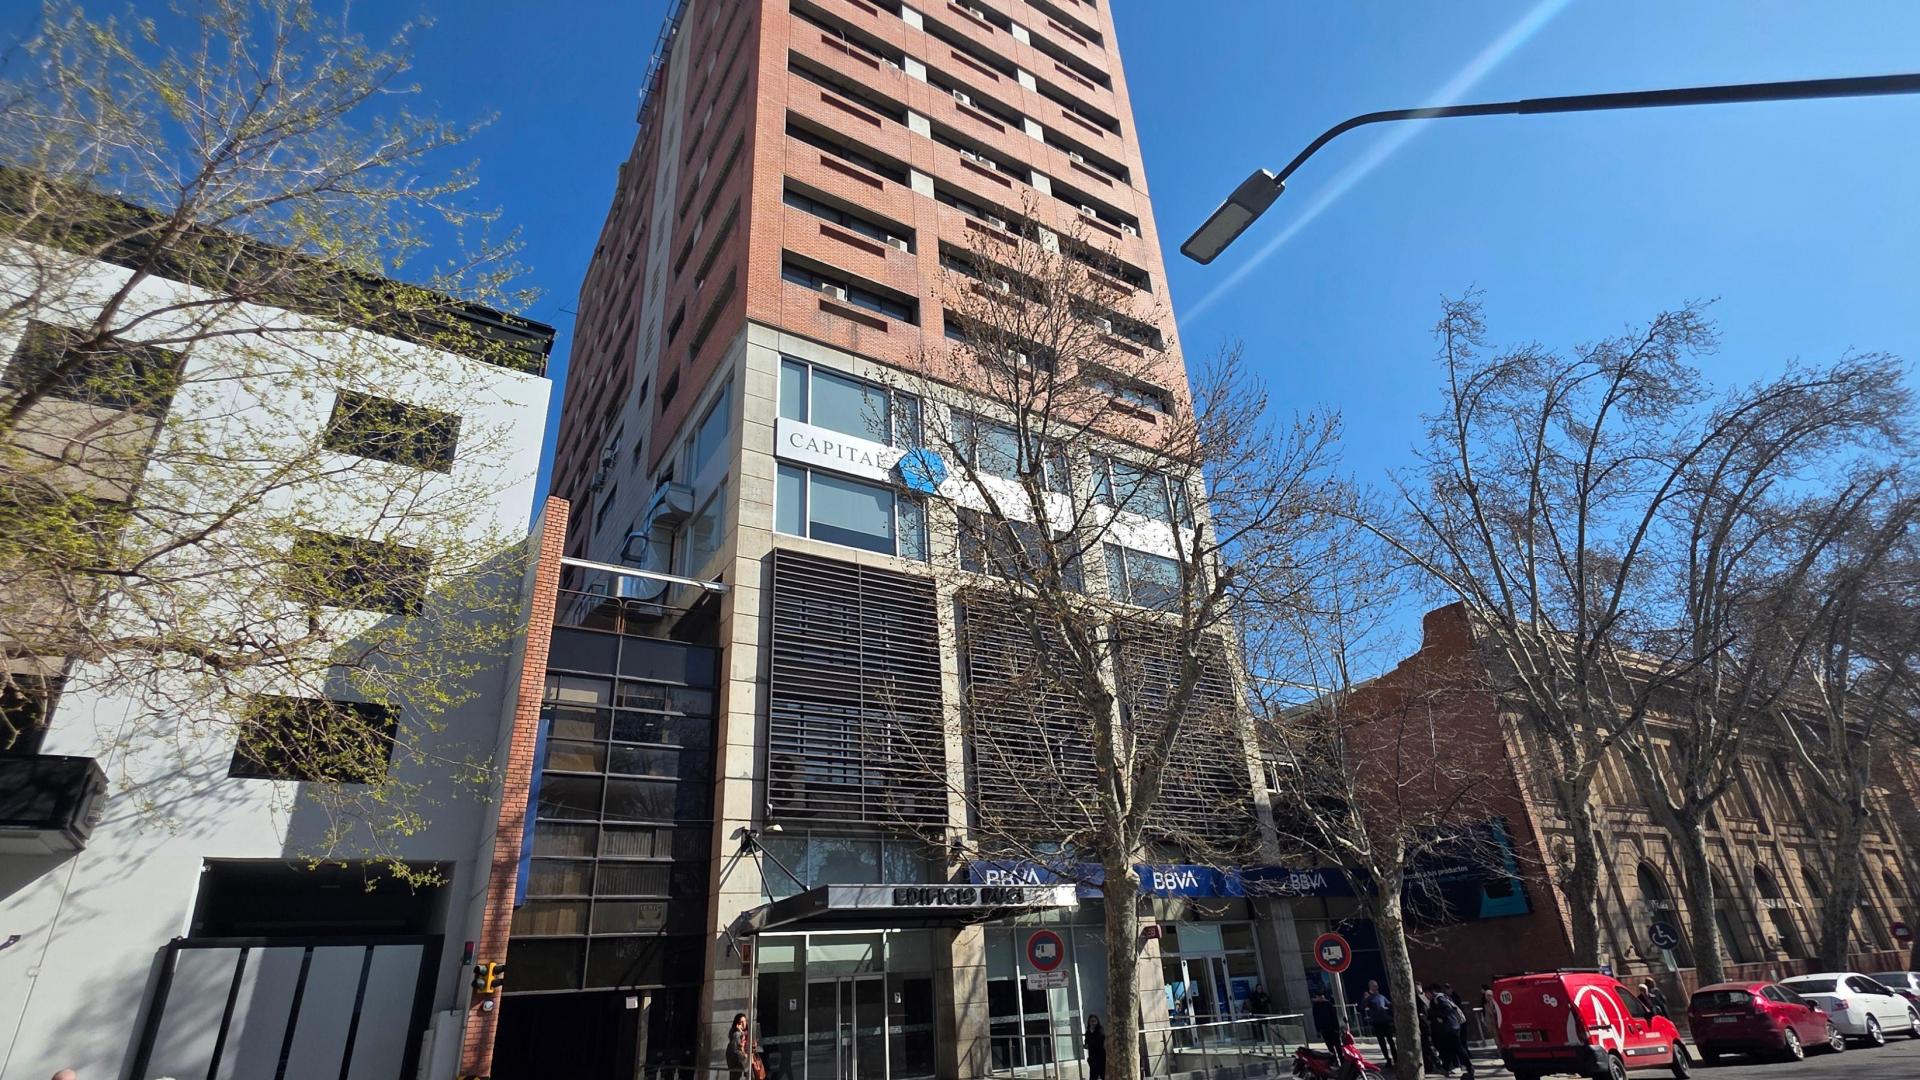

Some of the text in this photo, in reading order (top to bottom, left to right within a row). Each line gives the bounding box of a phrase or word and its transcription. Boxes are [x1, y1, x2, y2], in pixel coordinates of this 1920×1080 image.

[986, 868, 1041, 885] BBVA
[1153, 870, 1199, 890] BBVA
[1290, 873, 1328, 890] BBVA
[892, 887, 978, 906] EDIFICIO
